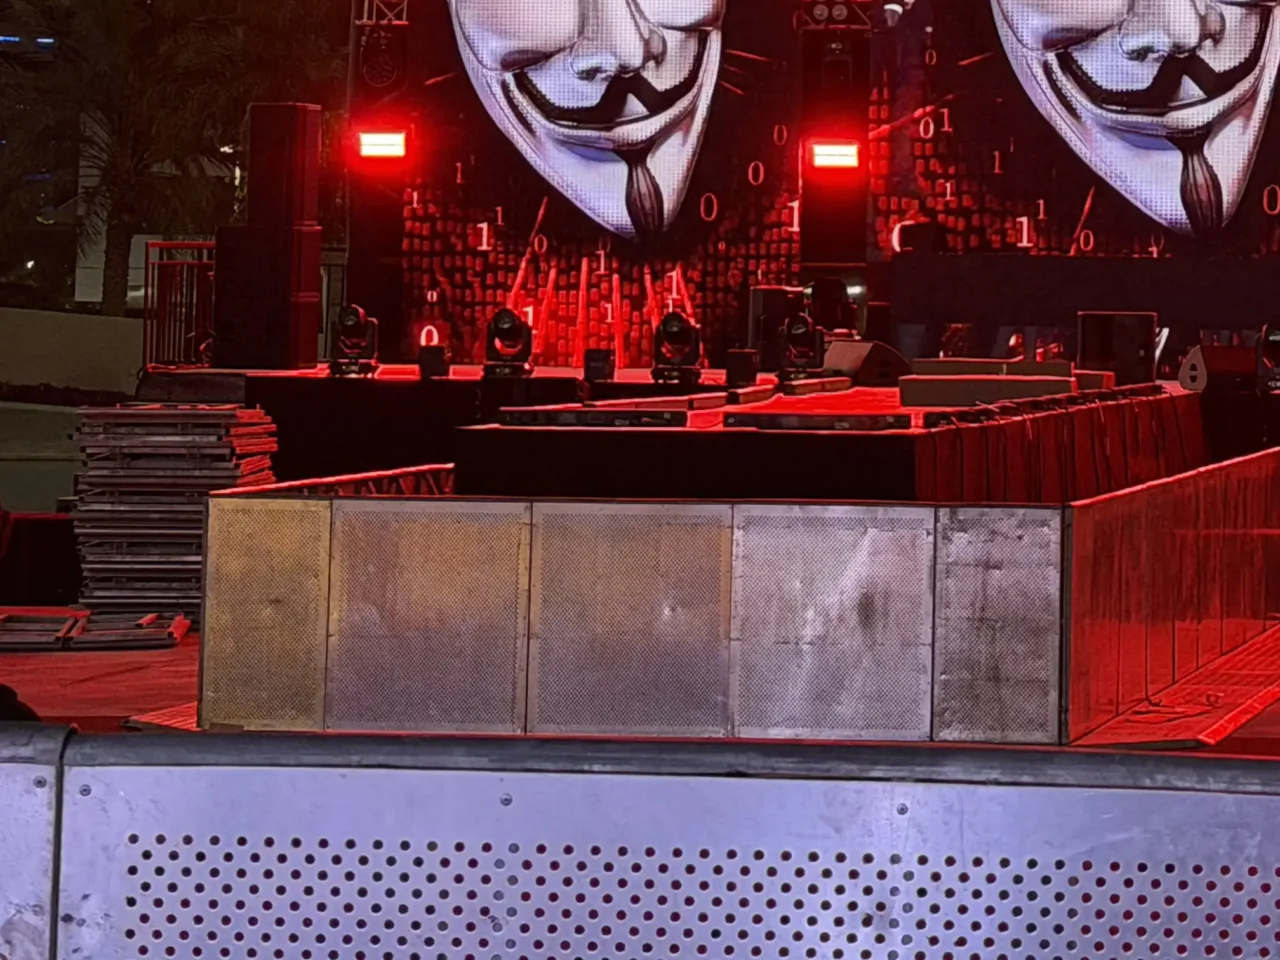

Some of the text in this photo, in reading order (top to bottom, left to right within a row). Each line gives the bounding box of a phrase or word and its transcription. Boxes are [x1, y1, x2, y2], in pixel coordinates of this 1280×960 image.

[925, 49, 937, 66] 0
[919, 116, 935, 138] 0
[939, 108, 953, 132] 1
[773, 124, 787, 145] 0
[993, 150, 1003, 173] 1
[456, 162, 464, 184] 1
[748, 161, 764, 185] 0
[411, 191, 418, 208] 1
[944, 182, 952, 200] 1
[496, 206, 504, 225] 1
[700, 193, 718, 221] 0
[788, 200, 800, 231] 1
[1036, 199, 1047, 219] 1
[477, 222, 492, 250] 1
[1016, 216, 1033, 247] 1
[1080, 230, 1094, 251] 0
[534, 235, 547, 253] 0
[596, 250, 609, 274] 1
[667, 270, 681, 299] 1
[427, 290, 437, 302] 0
[605, 304, 614, 322] 1
